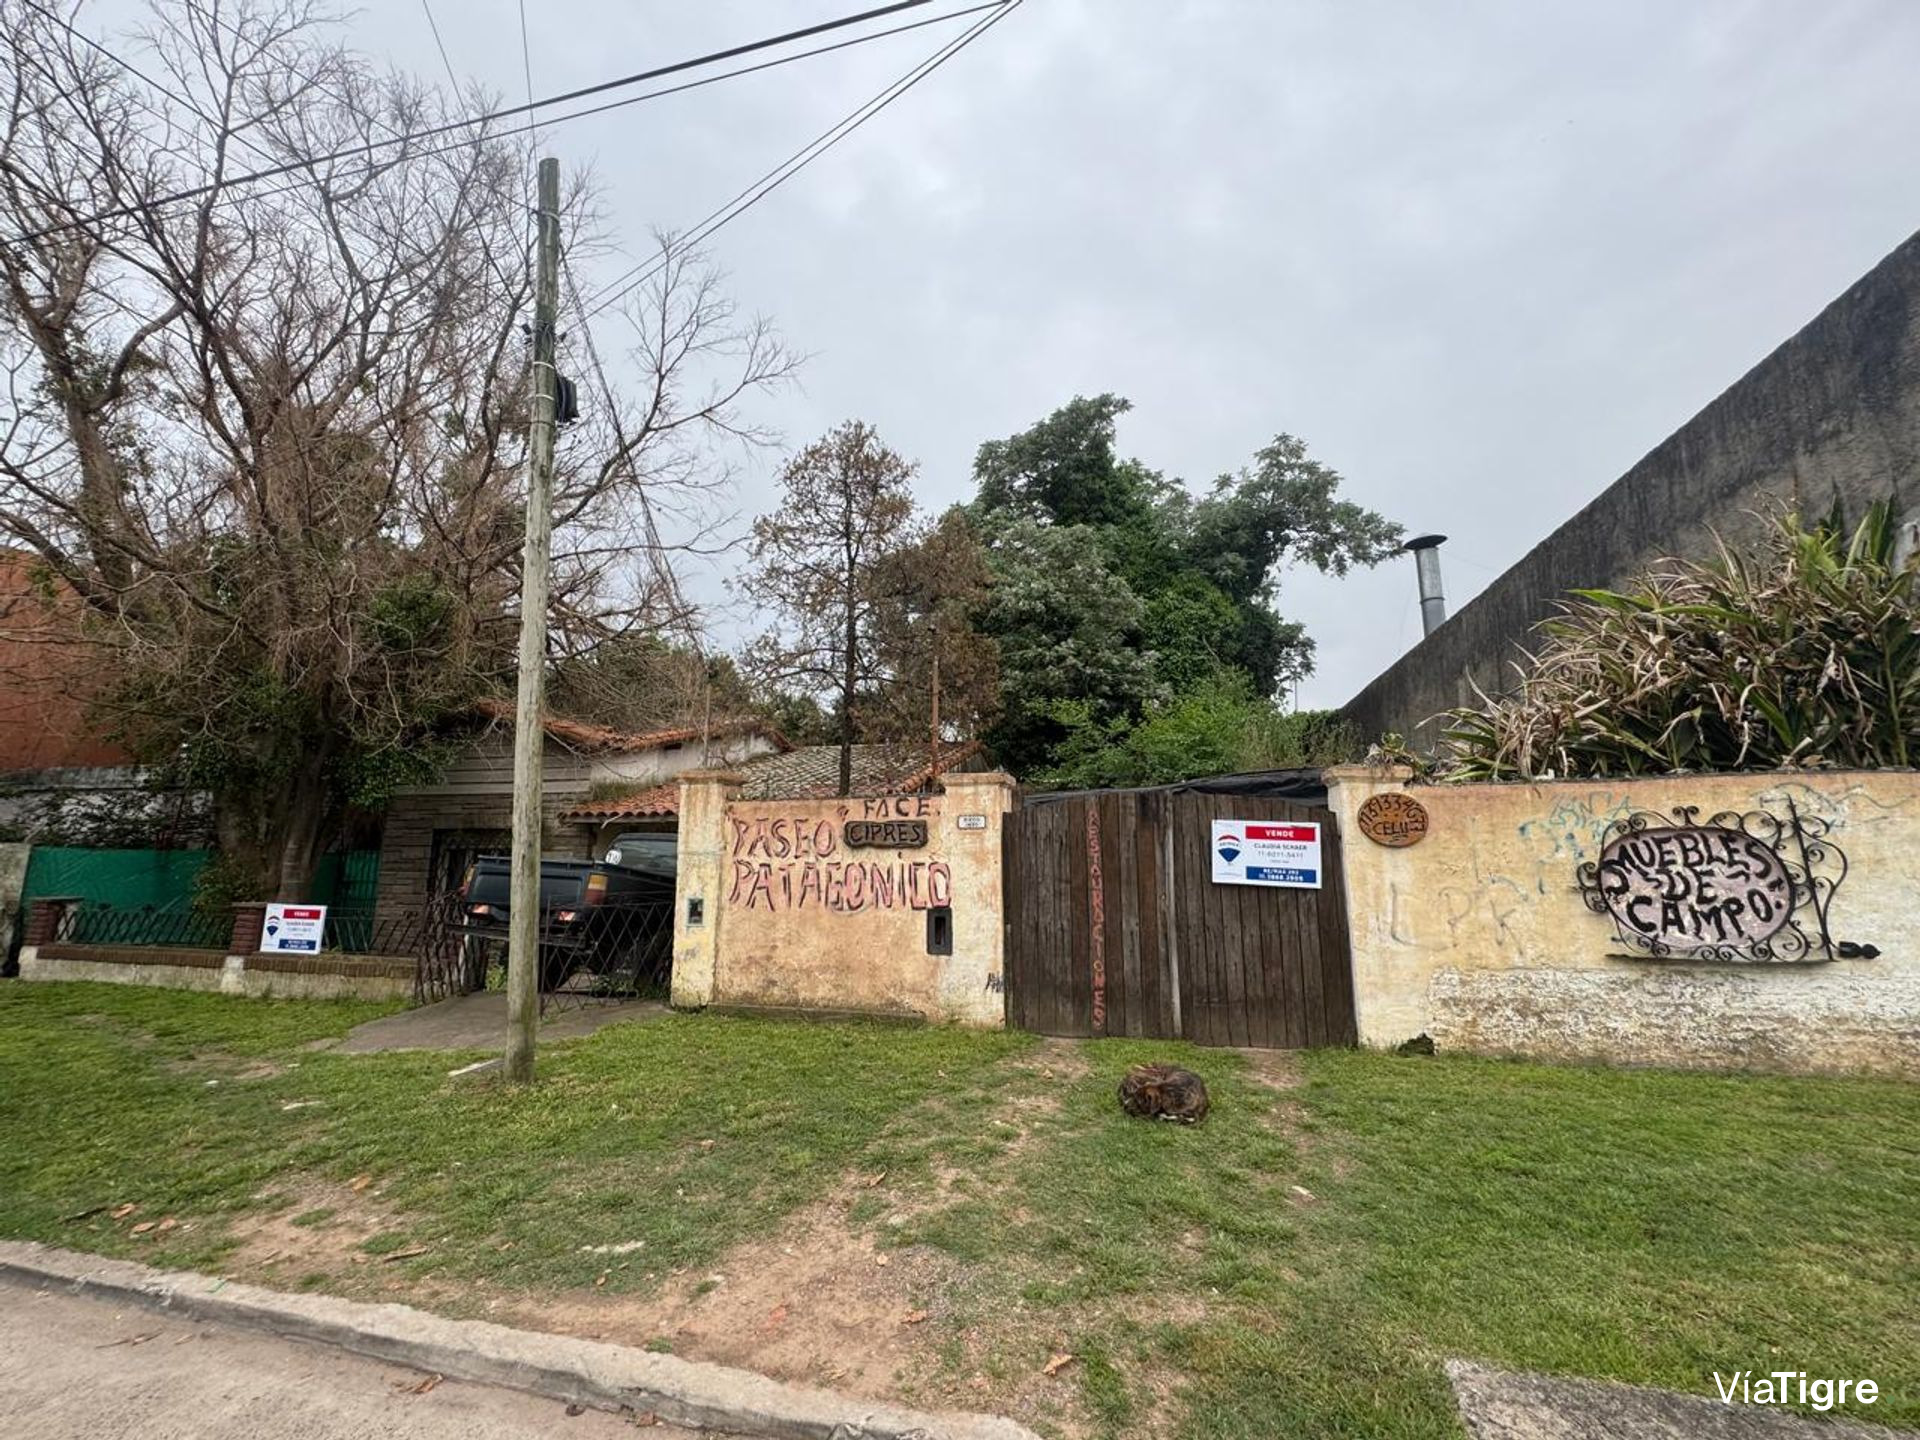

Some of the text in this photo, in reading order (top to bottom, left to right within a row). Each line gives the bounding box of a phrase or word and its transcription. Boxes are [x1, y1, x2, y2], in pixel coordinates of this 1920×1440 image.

[850, 823, 921, 842] CIPRES
[1264, 829, 1295, 838] VENDE
[1601, 833, 1772, 895] MUEBLES
[1656, 868, 1719, 905] DE
